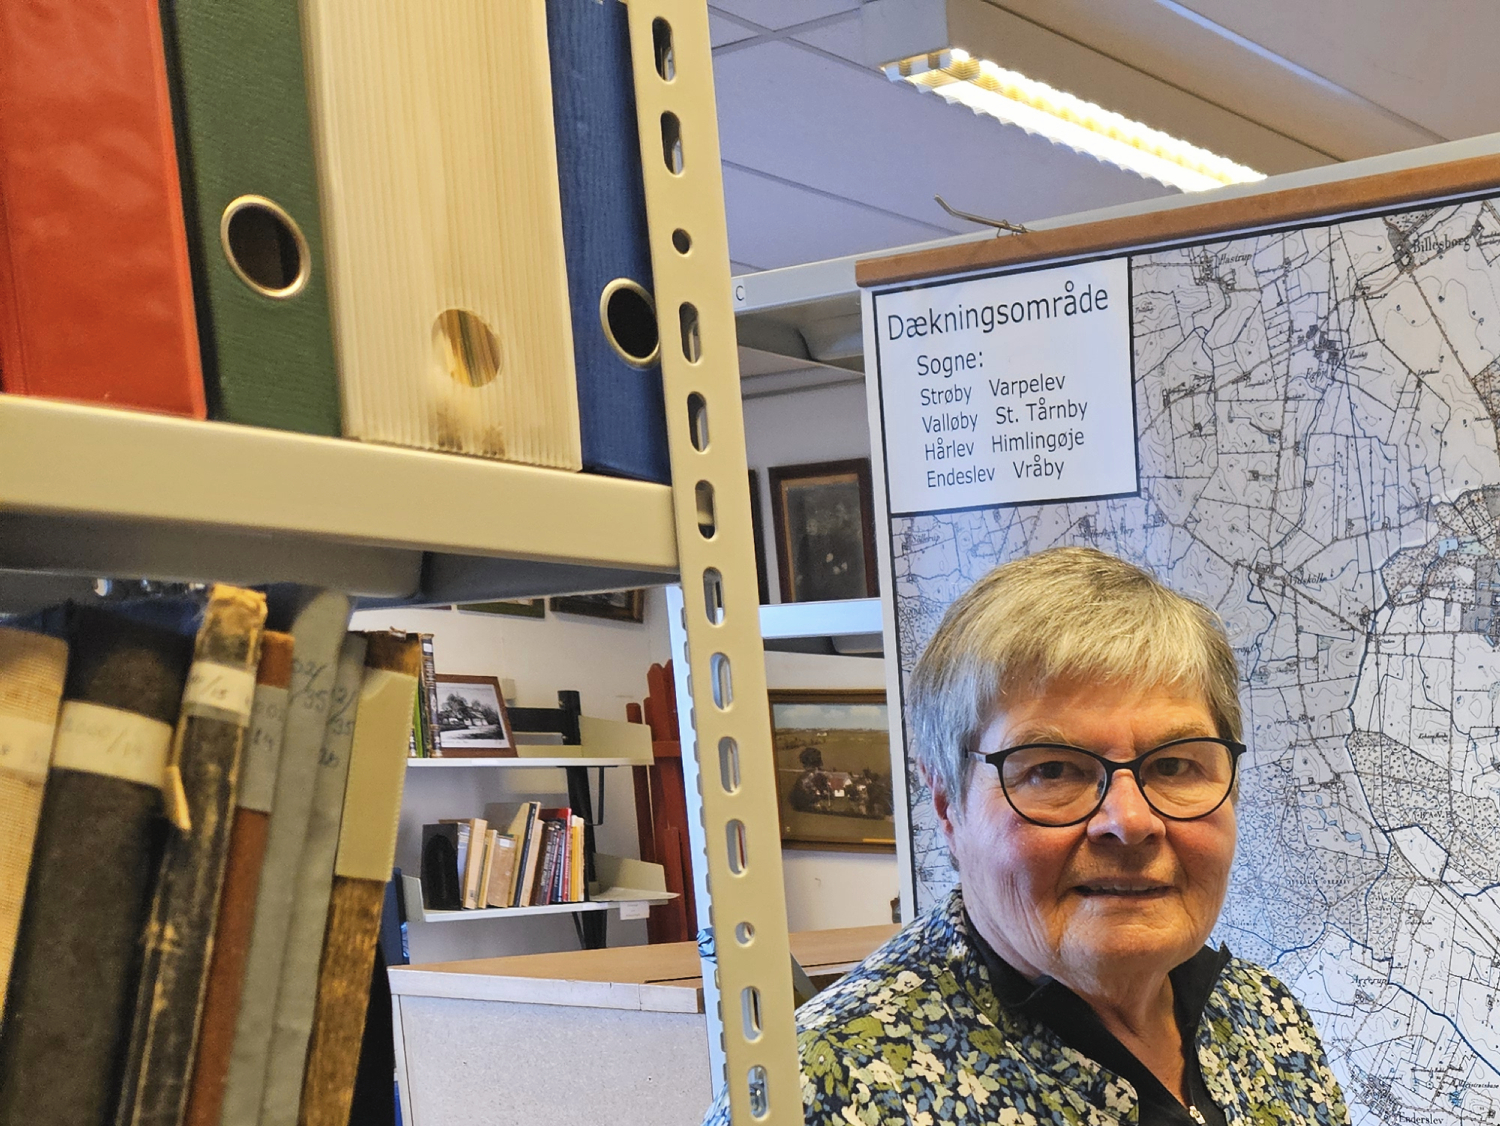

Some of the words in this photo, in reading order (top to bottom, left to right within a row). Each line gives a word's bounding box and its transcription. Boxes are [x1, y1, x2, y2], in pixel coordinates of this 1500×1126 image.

[735, 285, 745, 302] C
[887, 280, 1109, 341] Dækningsområde
[916, 351, 984, 378] Sogne:
[920, 385, 972, 406] Strøby
[988, 373, 1066, 398] Varpelev
[922, 412, 978, 433] Valløby
[995, 407, 1019, 425] St.
[1025, 397, 1088, 422] Tårnby
[924, 437, 975, 461] Hårlev
[991, 428, 1085, 453] Himlingøje
[927, 466, 996, 488] Endeslev
[1012, 455, 1065, 480] Vråby
